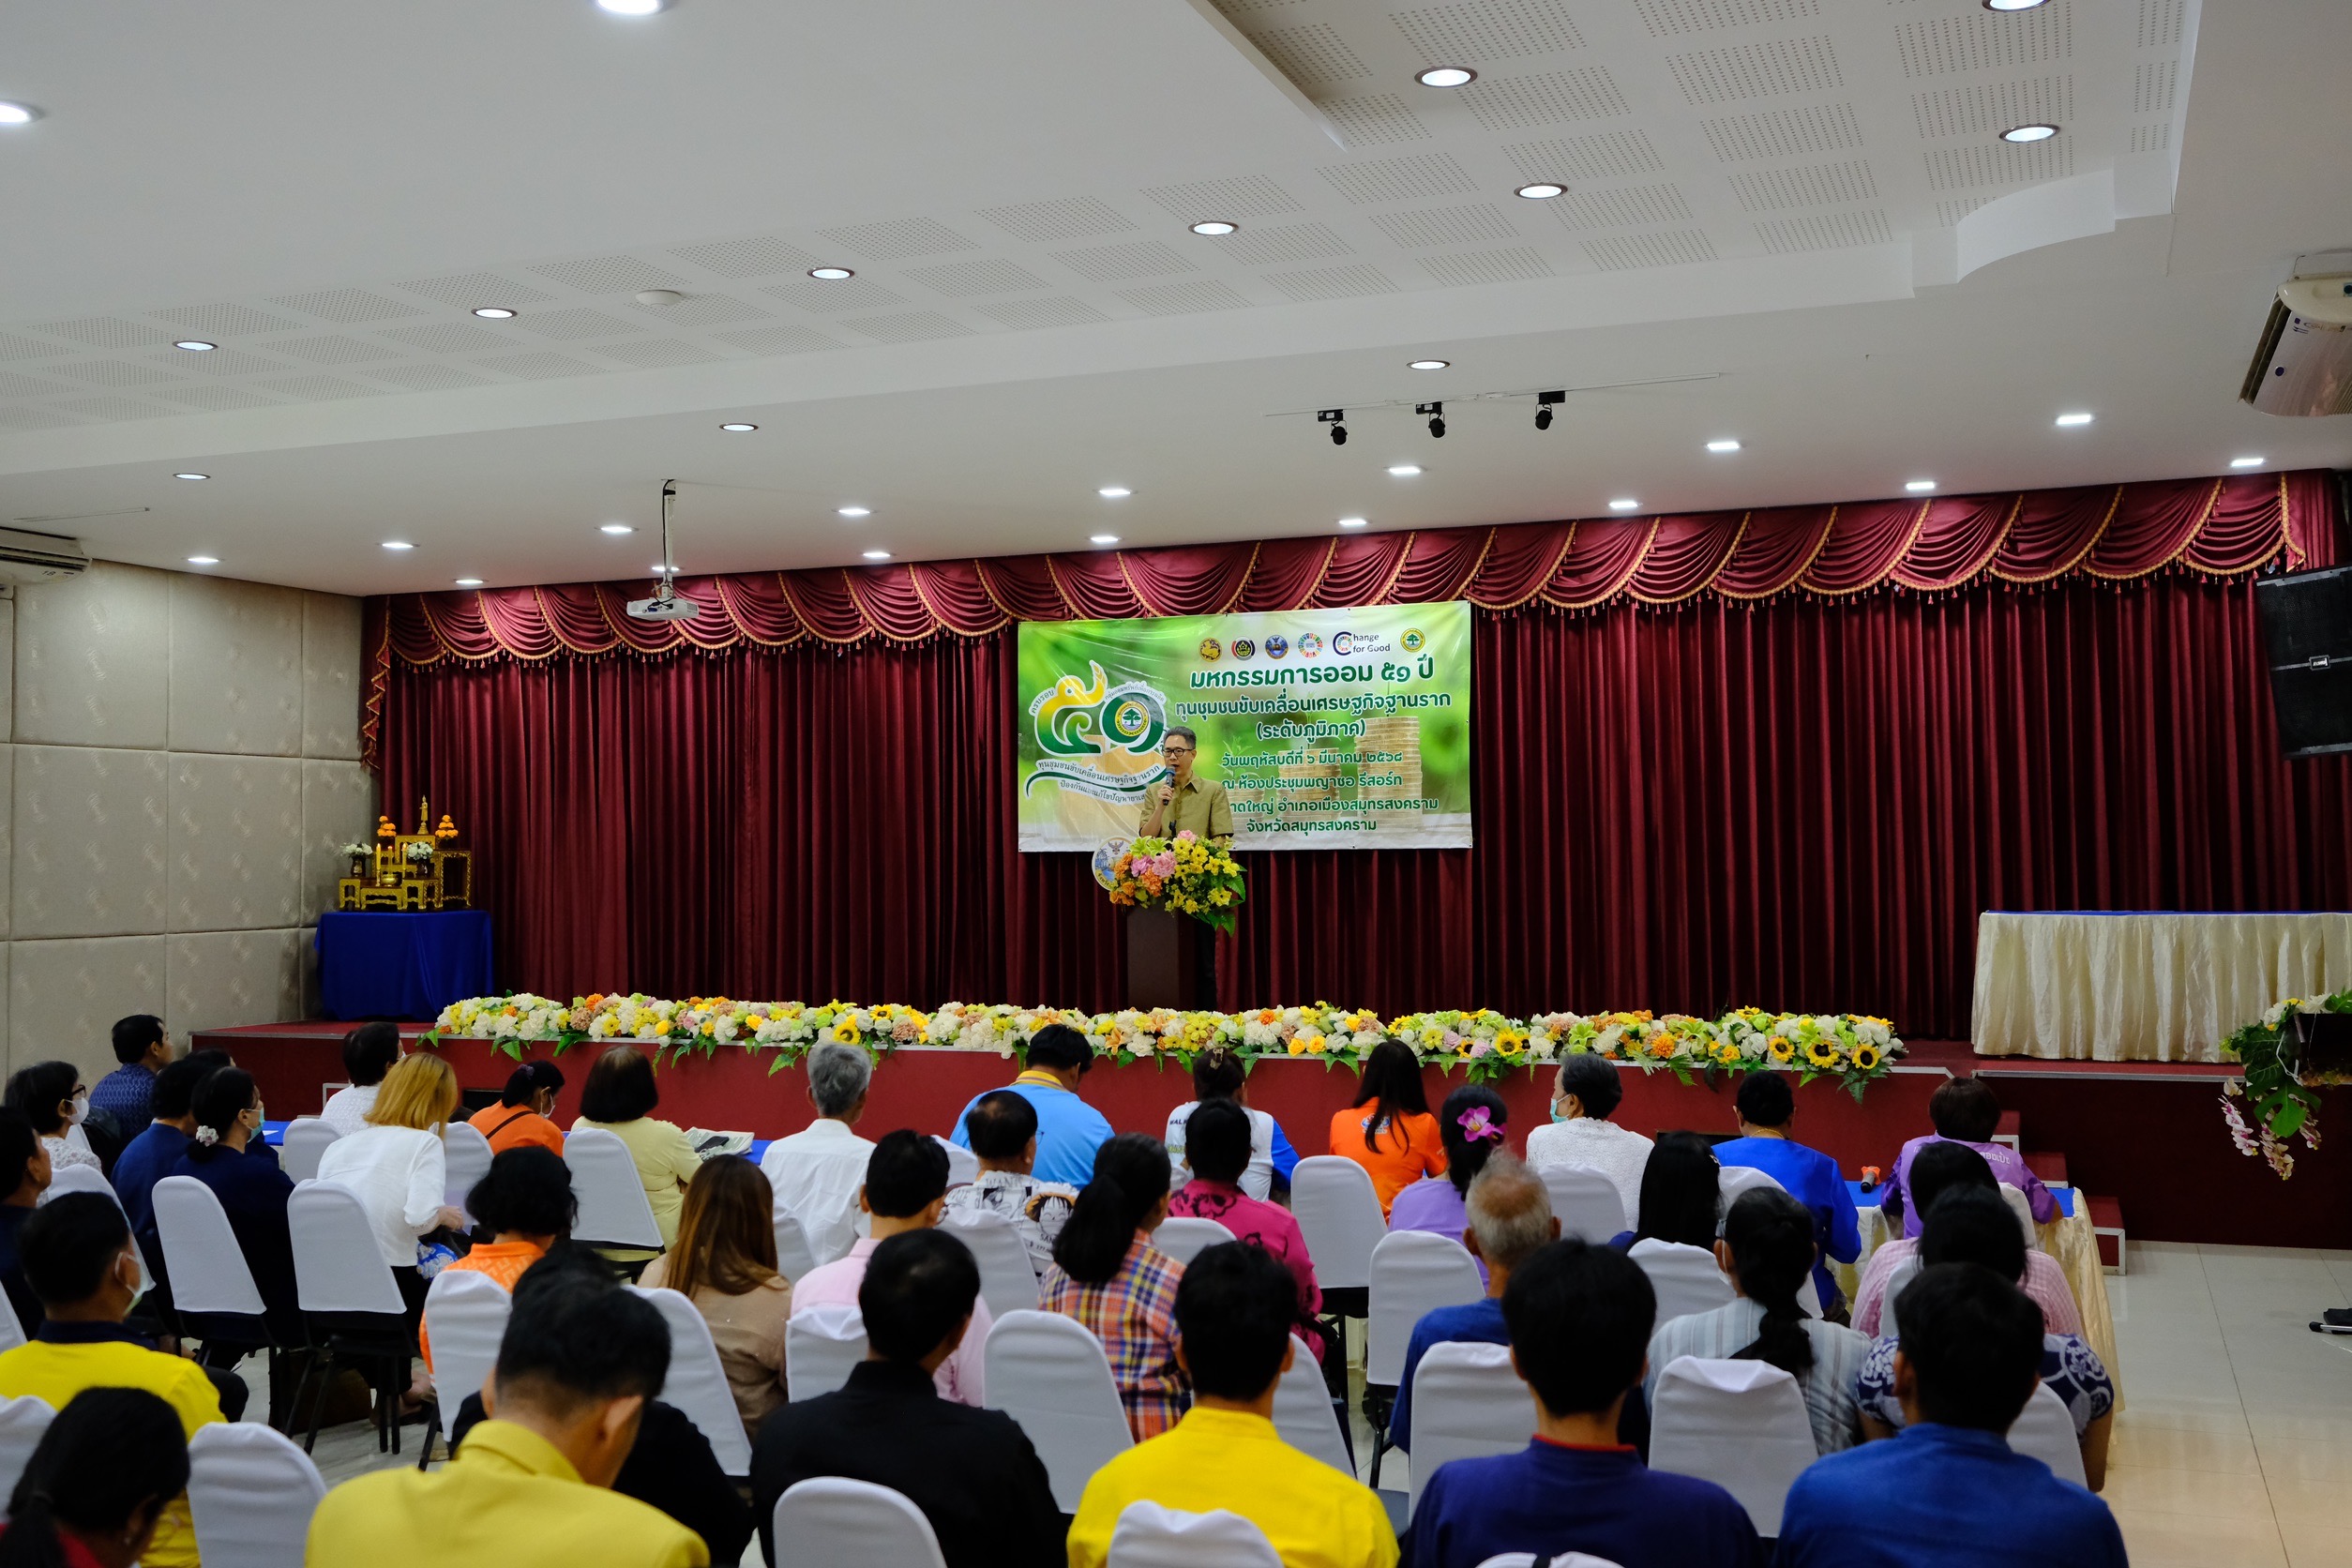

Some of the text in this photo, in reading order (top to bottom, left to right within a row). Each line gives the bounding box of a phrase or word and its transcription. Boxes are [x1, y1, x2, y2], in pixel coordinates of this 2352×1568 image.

[1352, 643, 1391, 654] for Good
[1191, 654, 1434, 688] มหกรรมการออม ๕๑ ปี
[1176, 688, 1451, 722] ทุนชุมชนขับเคลื่อนเศรษฐกิจฐานราก
[1257, 719, 1366, 743] (ระดับภูมิภาค)
[1222, 746, 1402, 768] วันพฤหัสบดีที่ ๖ มีนาคม ๒๕๖๘
[1222, 771, 1402, 793] ณ ห้องประชุมพญาซอ รีสอร์ท
[1229, 796, 1439, 815] าดใหญ่ อำเภอเมืองสมุทรสงคราม
[1247, 818, 1377, 836] จังหวัดสมุทรสงคราม
